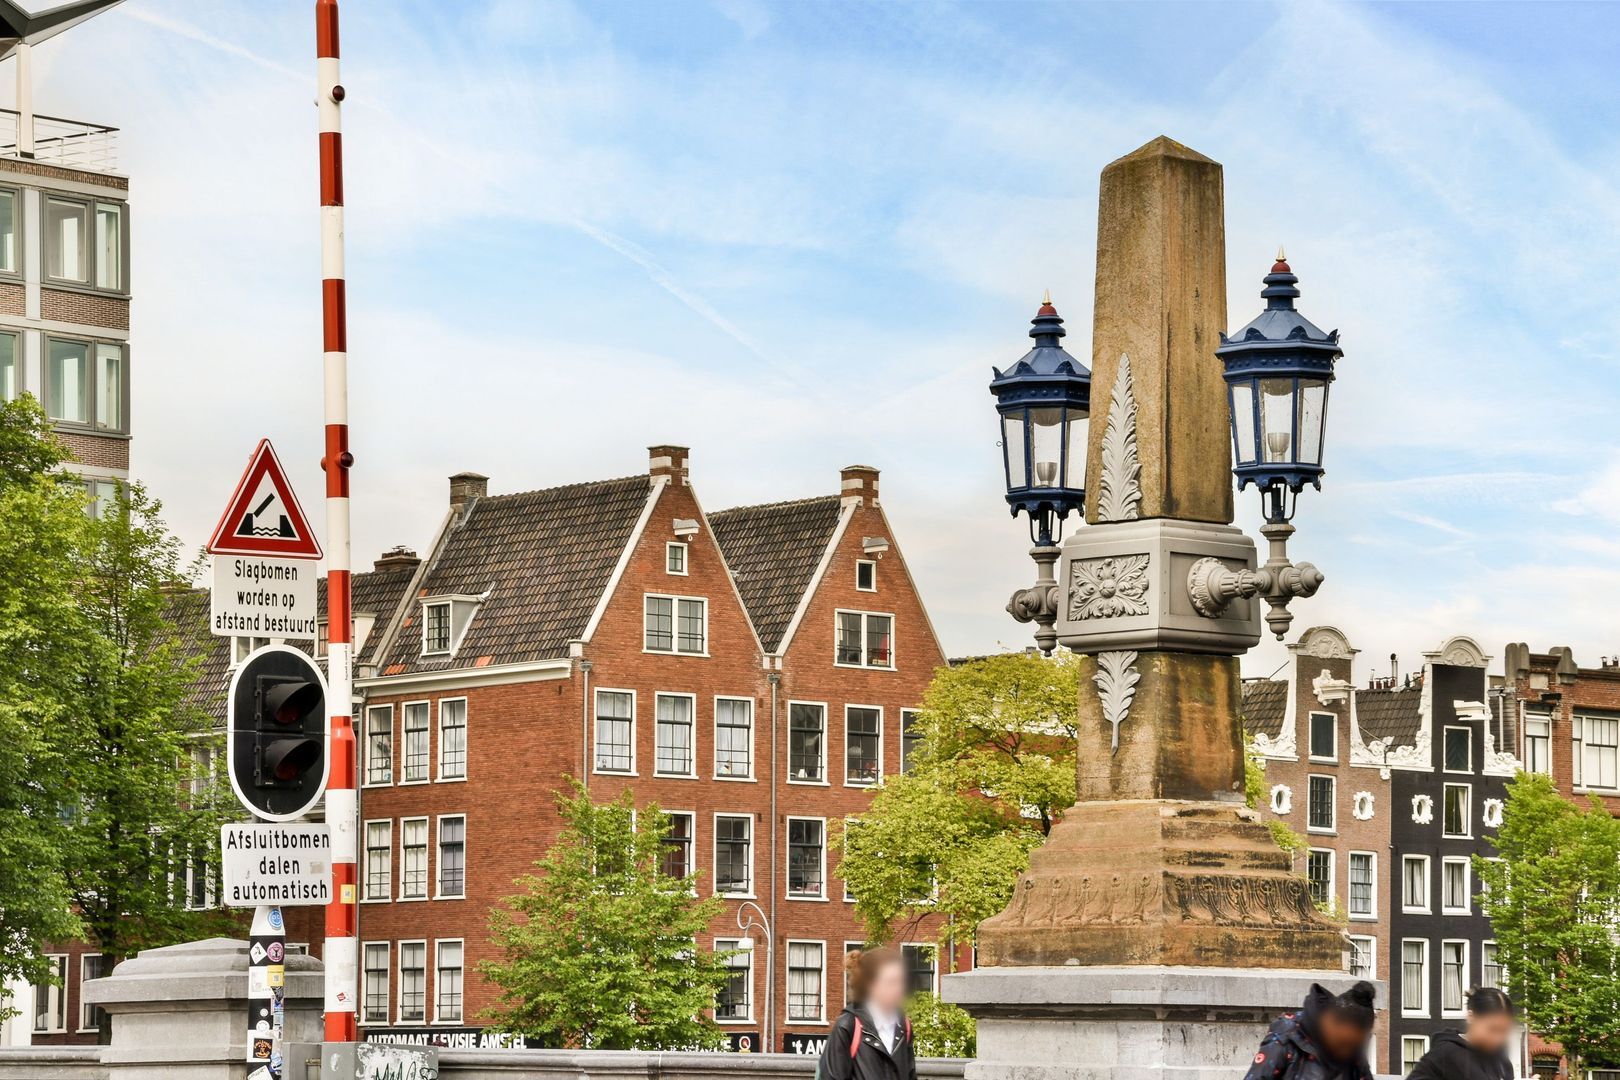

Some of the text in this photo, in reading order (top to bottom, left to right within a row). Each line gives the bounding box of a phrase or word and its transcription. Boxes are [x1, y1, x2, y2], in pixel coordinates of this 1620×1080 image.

[234, 559, 298, 584] Slagbomen
[237, 588, 295, 611] worden op
[216, 611, 315, 634] afstand bestuurd
[227, 830, 330, 849] Afsluitbomen
[259, 855, 300, 875] dalen
[233, 879, 327, 900] automatisch
[366, 1033, 430, 1046] AUTOMAAT
